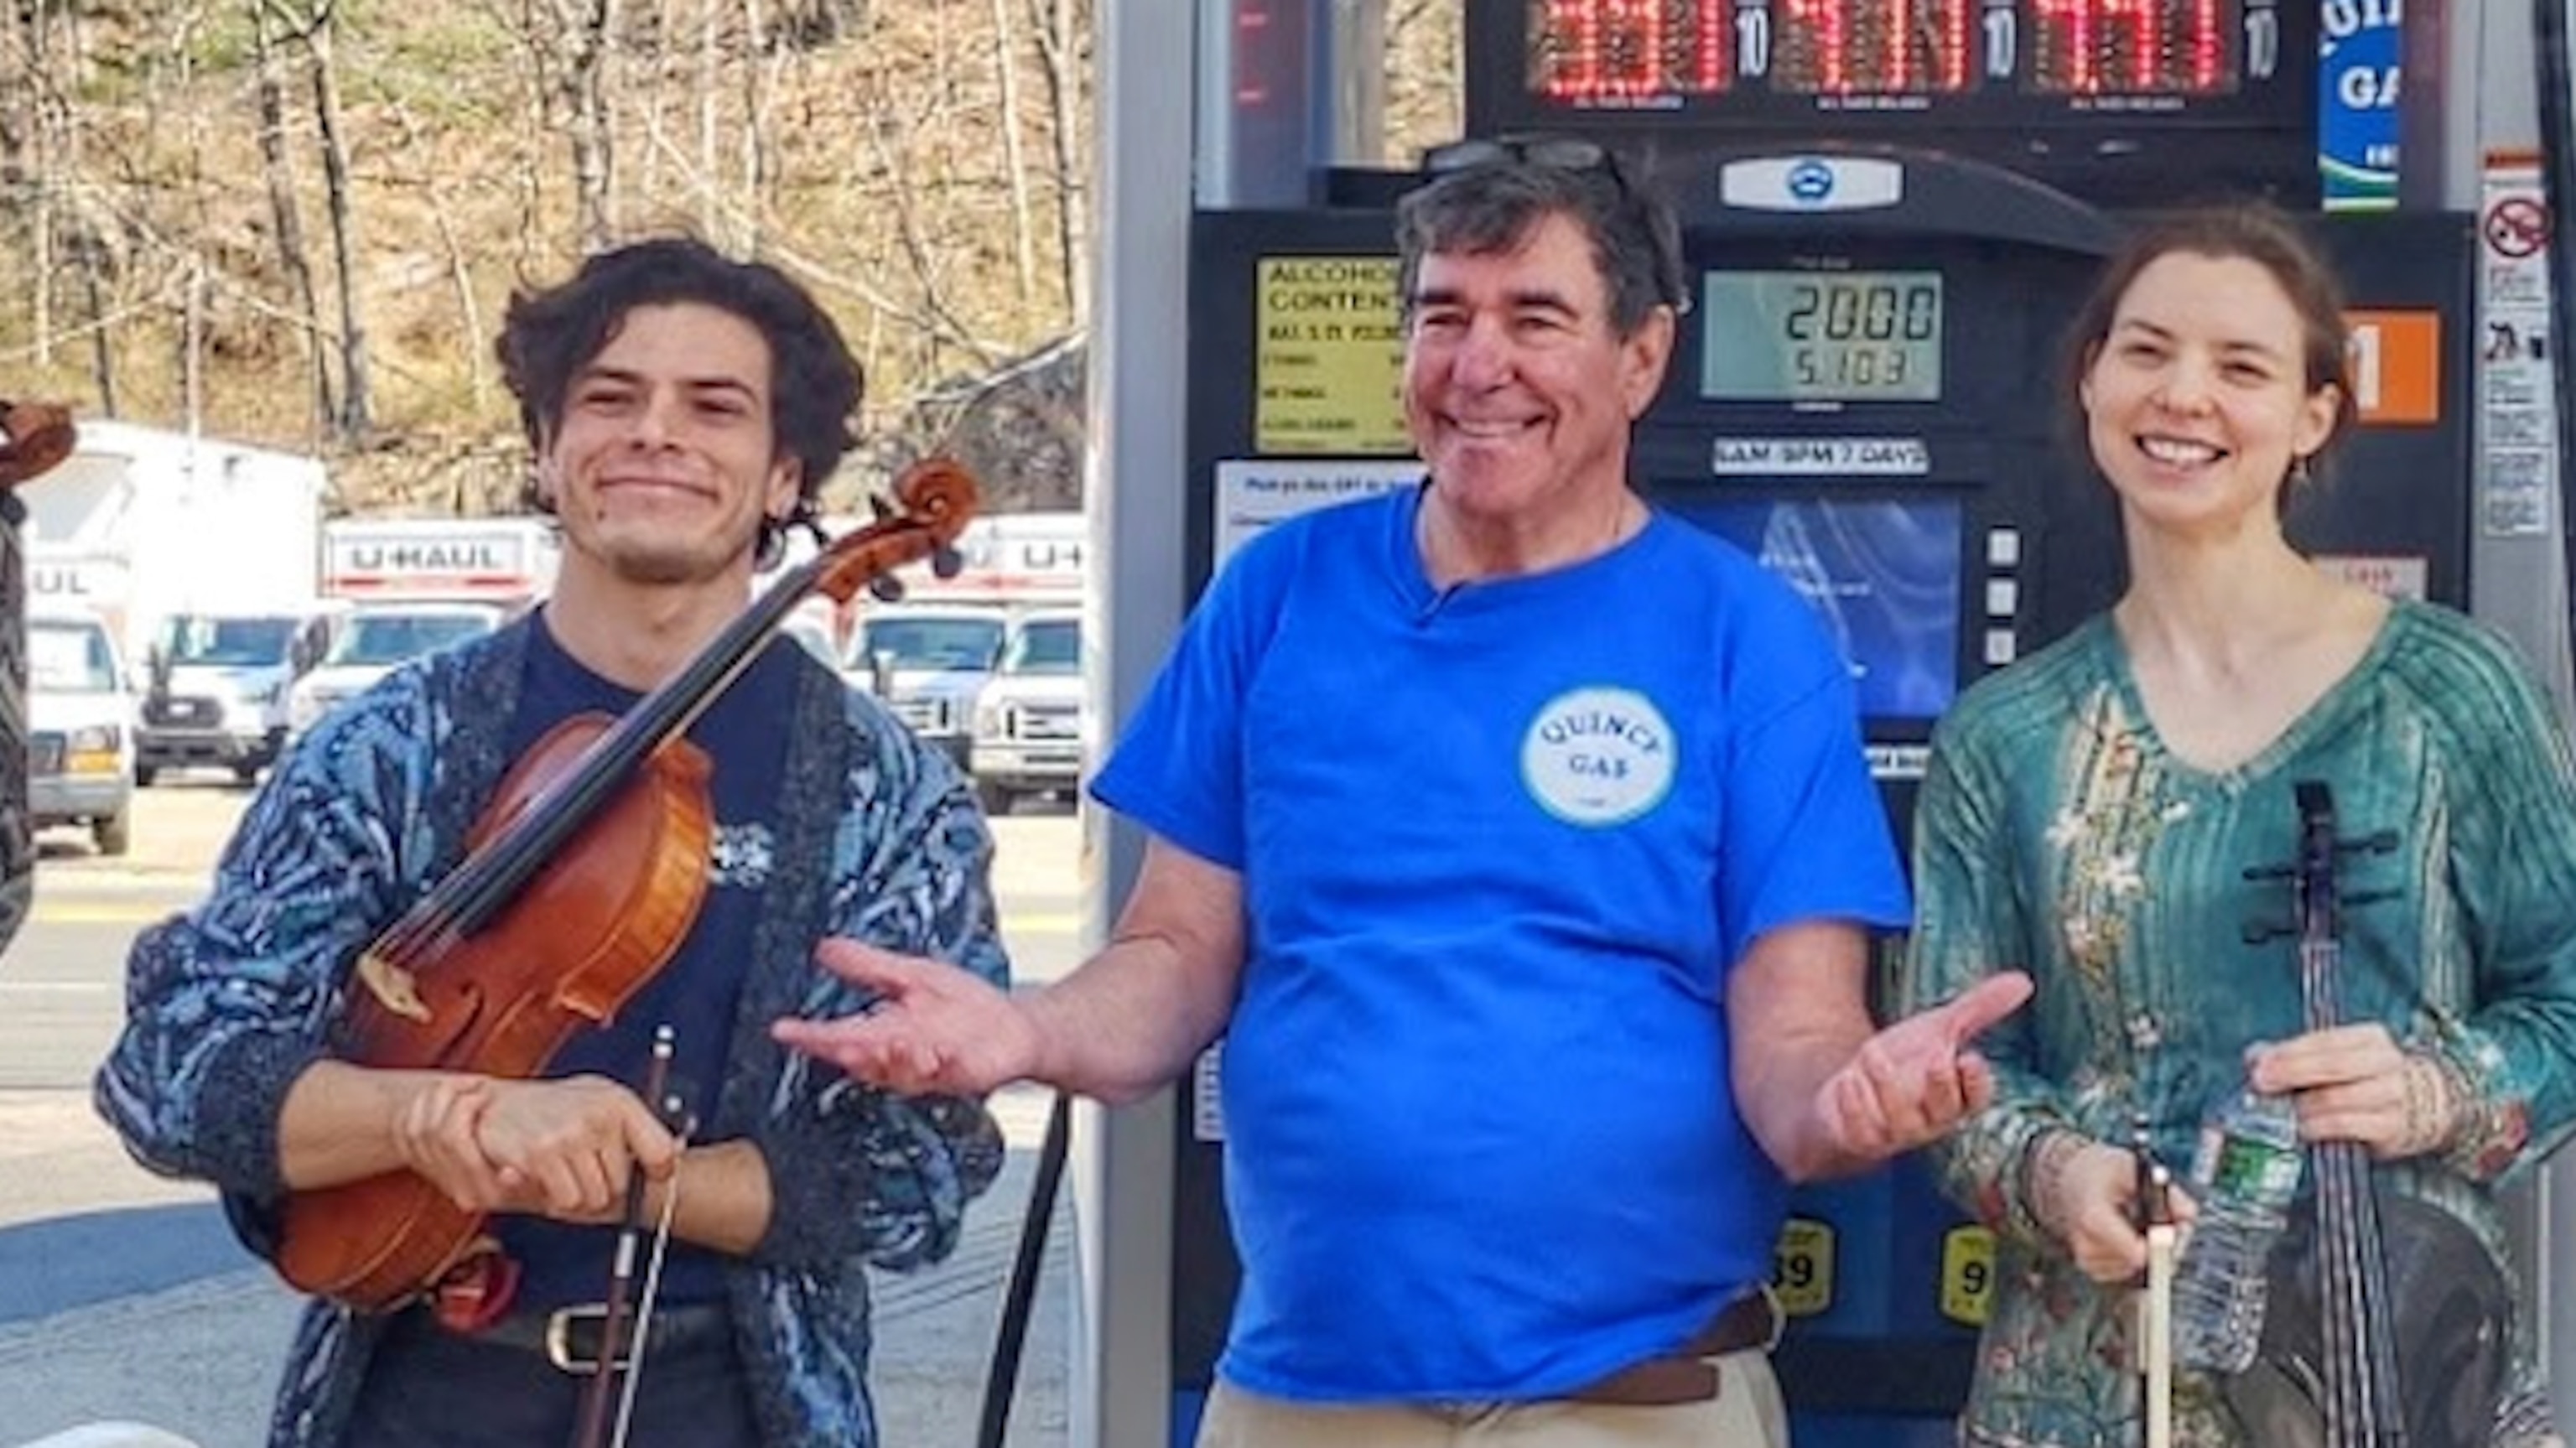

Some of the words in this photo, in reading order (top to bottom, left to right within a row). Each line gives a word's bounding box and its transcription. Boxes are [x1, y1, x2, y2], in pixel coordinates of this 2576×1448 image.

[1736, 8, 1769, 76] 10
[1982, 8, 2017, 77] 10
[2244, 8, 2277, 77] 10
[1268, 262, 1400, 283] ALCOHO
[1268, 292, 1390, 311] CONTEN
[1540, 711, 1664, 755] QUINCY
[1569, 754, 1629, 780] GAS
[1963, 1261, 1987, 1295] 9
